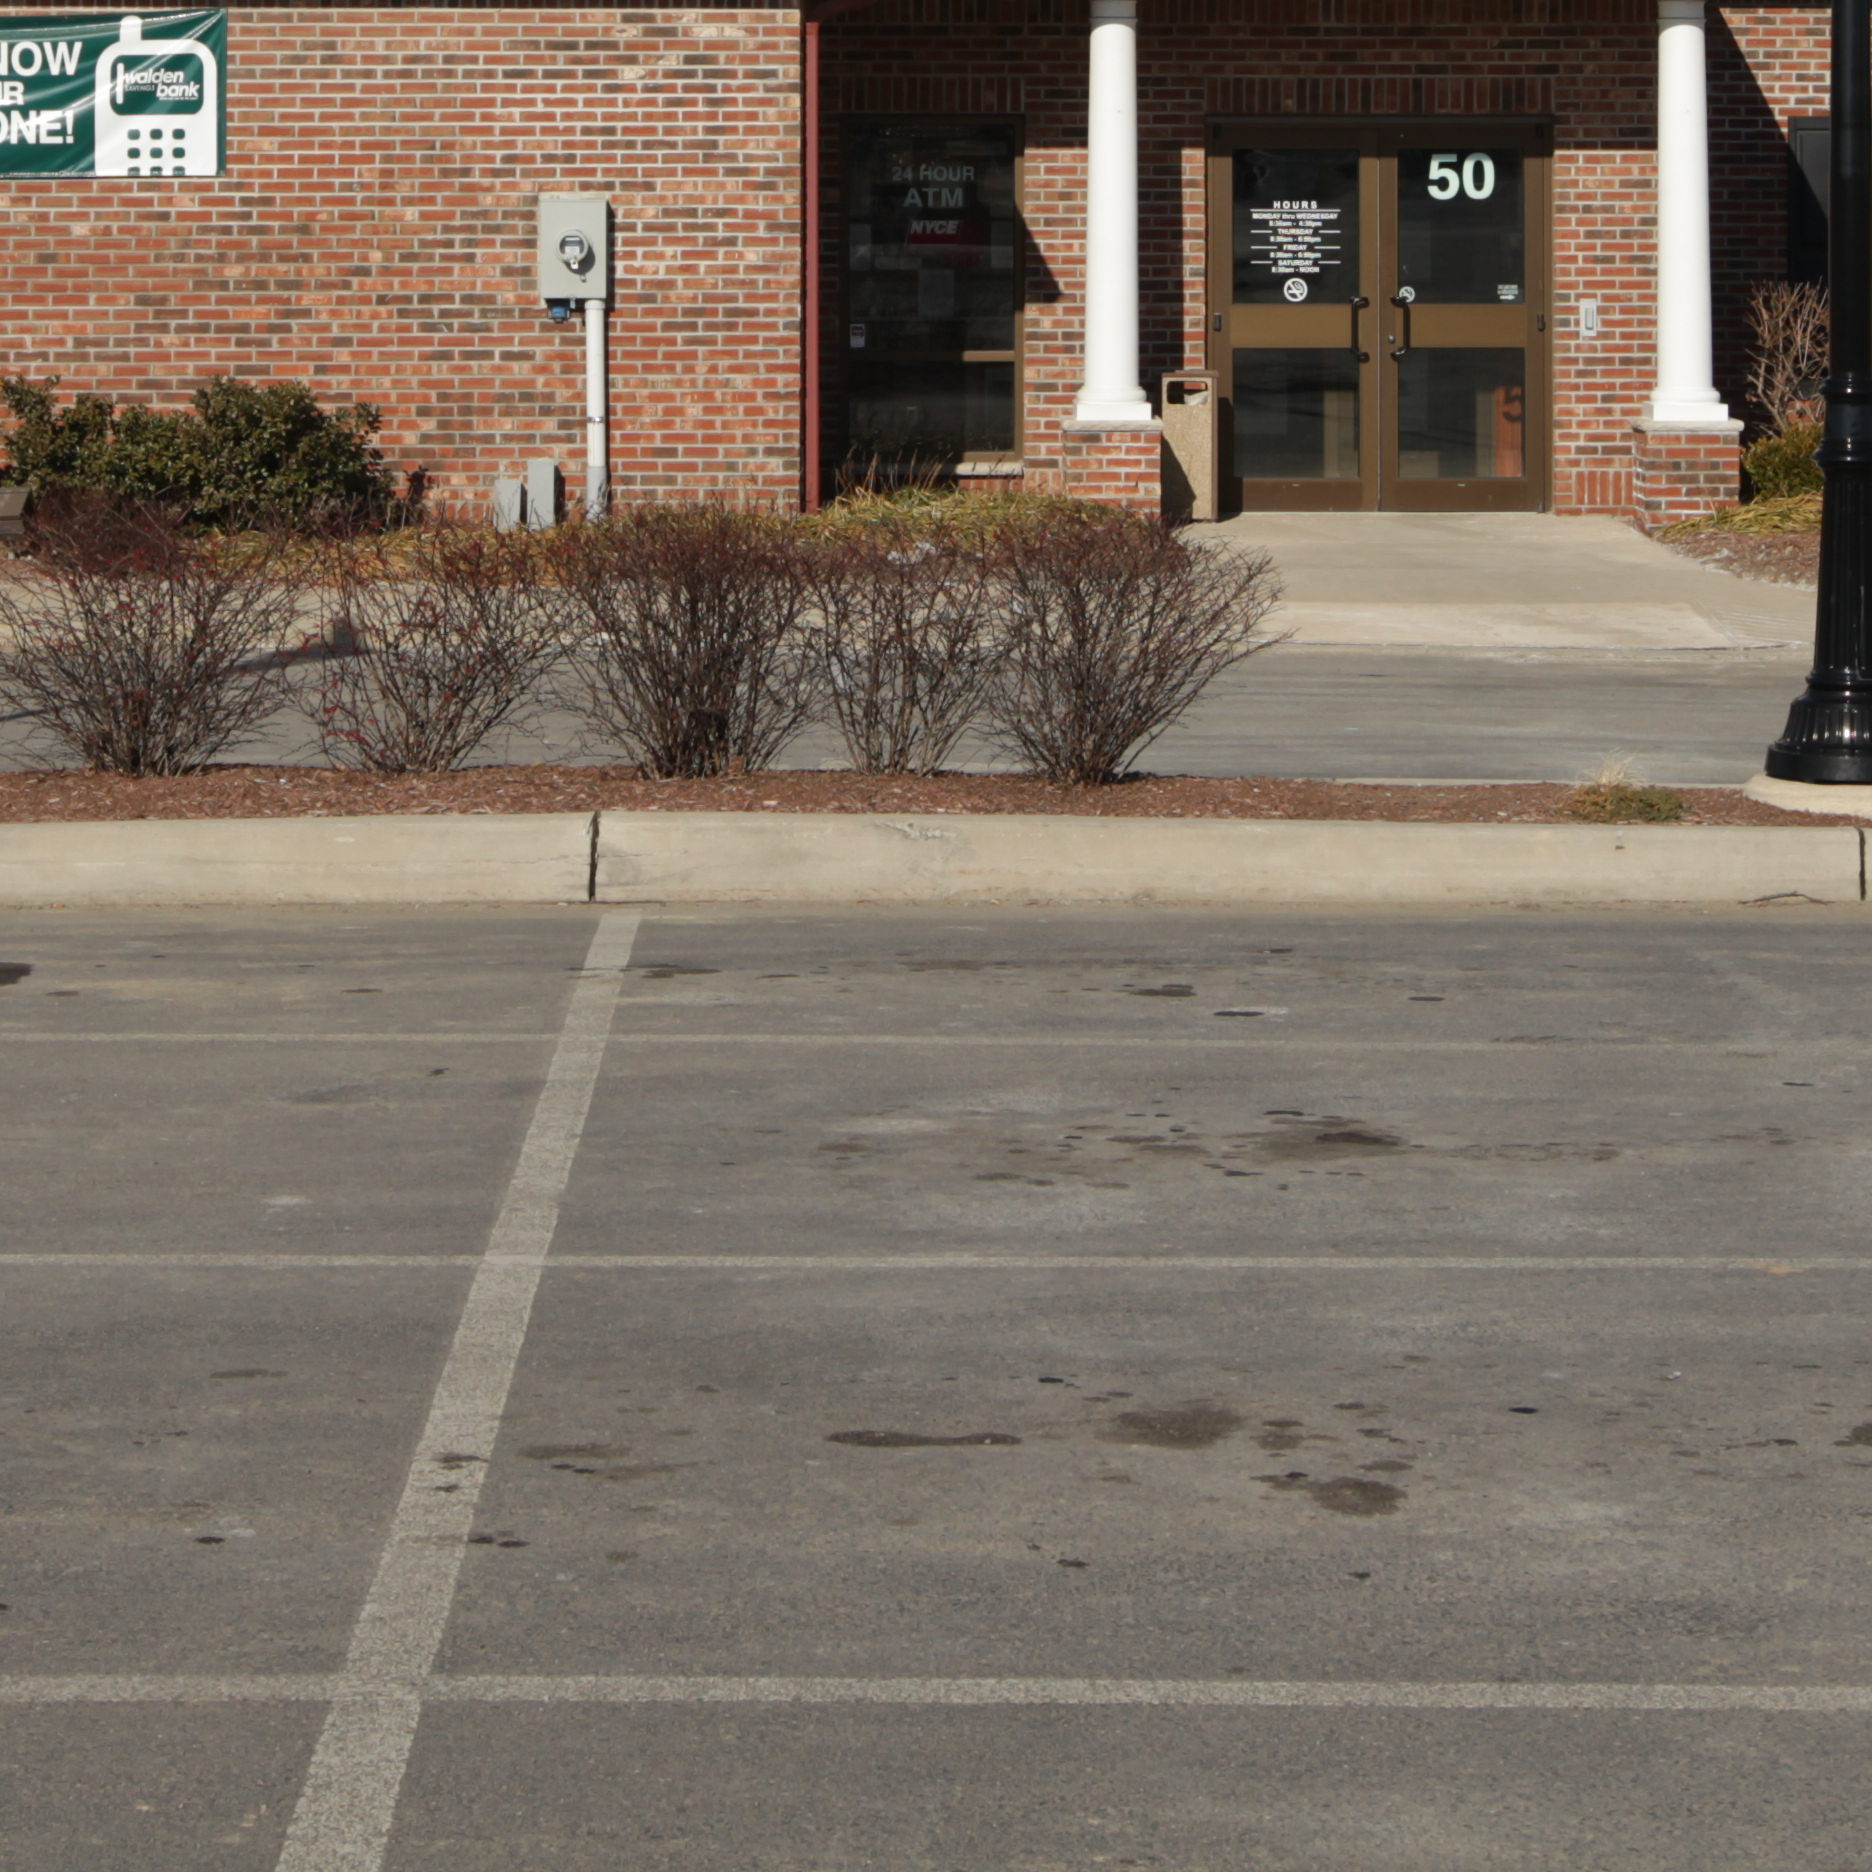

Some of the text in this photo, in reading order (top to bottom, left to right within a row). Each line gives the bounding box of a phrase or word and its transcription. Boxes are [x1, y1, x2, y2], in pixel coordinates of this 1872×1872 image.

[124, 68, 184, 84] walden
[156, 81, 200, 97] bank
[892, 165, 975, 182] 24 HOUR
[1427, 152, 1496, 200] 50
[903, 187, 964, 208] ATM
[1273, 200, 1318, 209] HOURS
[909, 219, 960, 235] NYCE
